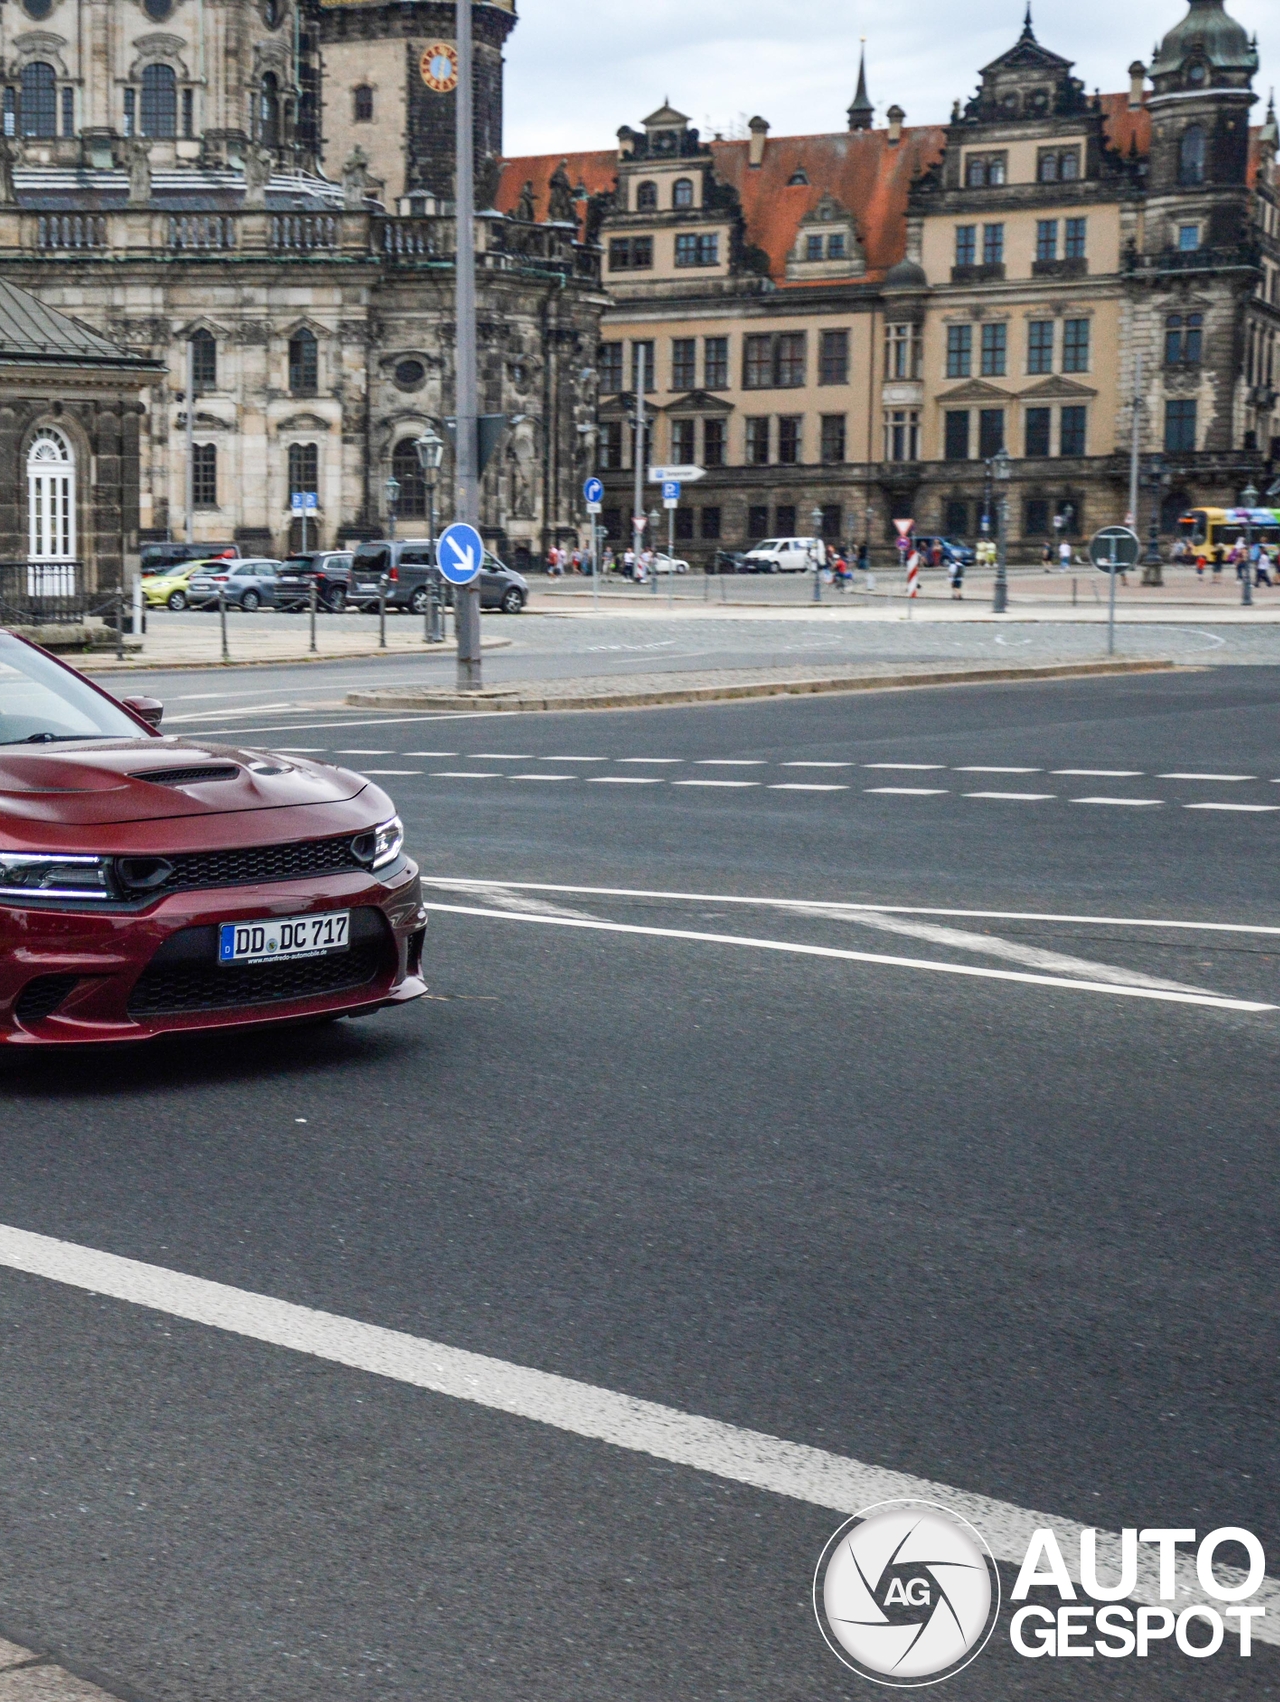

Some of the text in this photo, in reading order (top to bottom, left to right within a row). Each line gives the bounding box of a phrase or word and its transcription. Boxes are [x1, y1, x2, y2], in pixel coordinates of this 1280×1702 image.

[236, 927, 265, 954] DD
[280, 922, 307, 949] DC
[312, 917, 348, 946] 717
